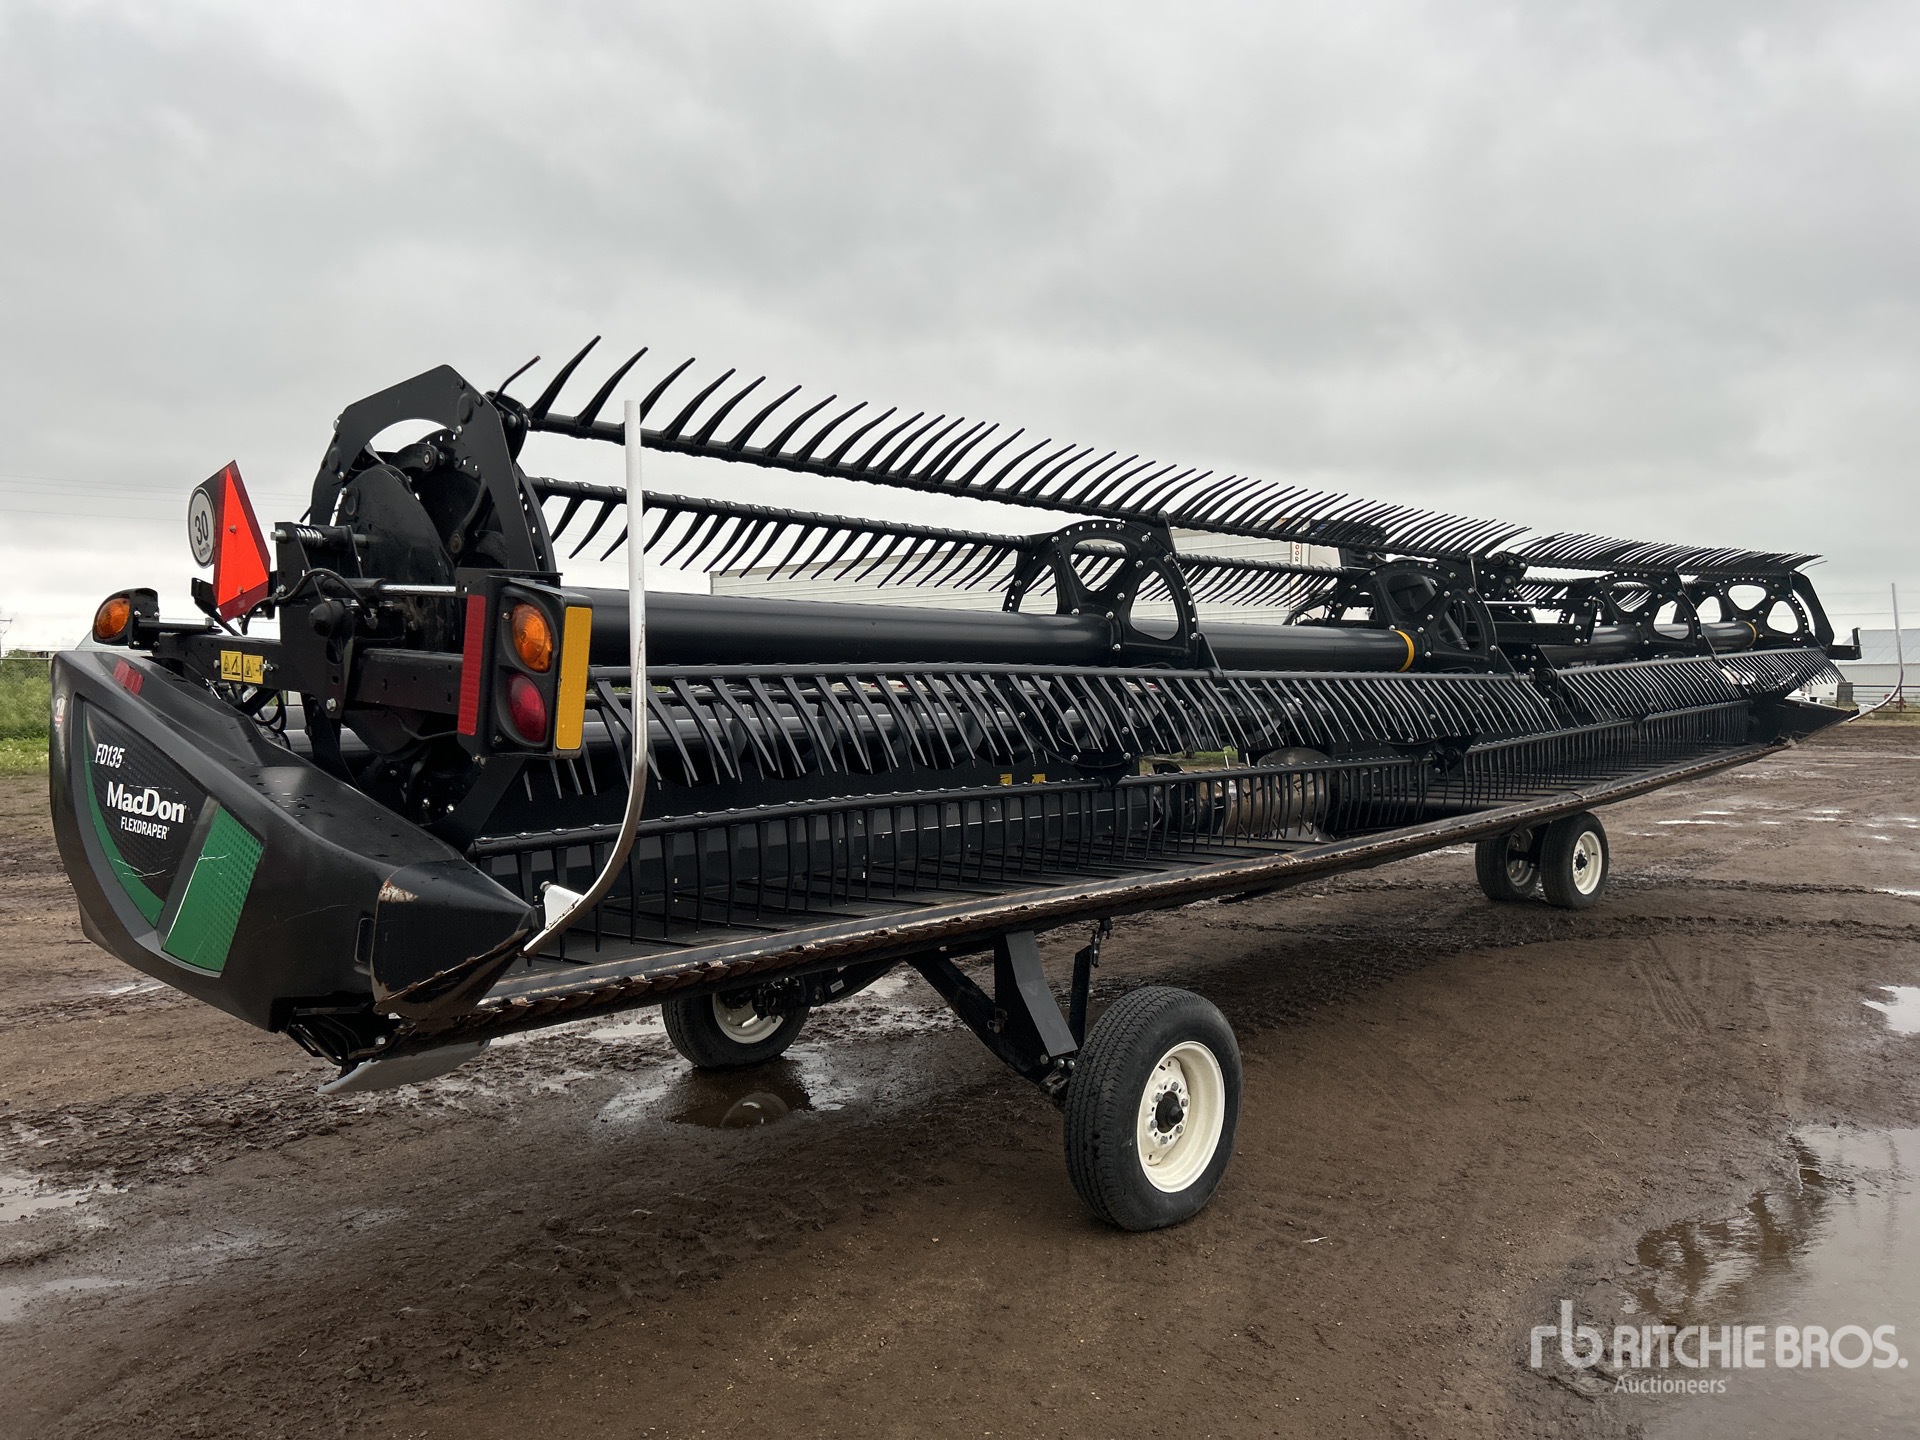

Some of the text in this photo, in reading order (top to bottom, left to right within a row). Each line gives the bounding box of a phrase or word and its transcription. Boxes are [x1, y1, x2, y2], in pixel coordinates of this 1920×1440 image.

[195, 510, 209, 546] 30
[95, 743, 125, 769] FD135
[106, 781, 185, 824] MacDon
